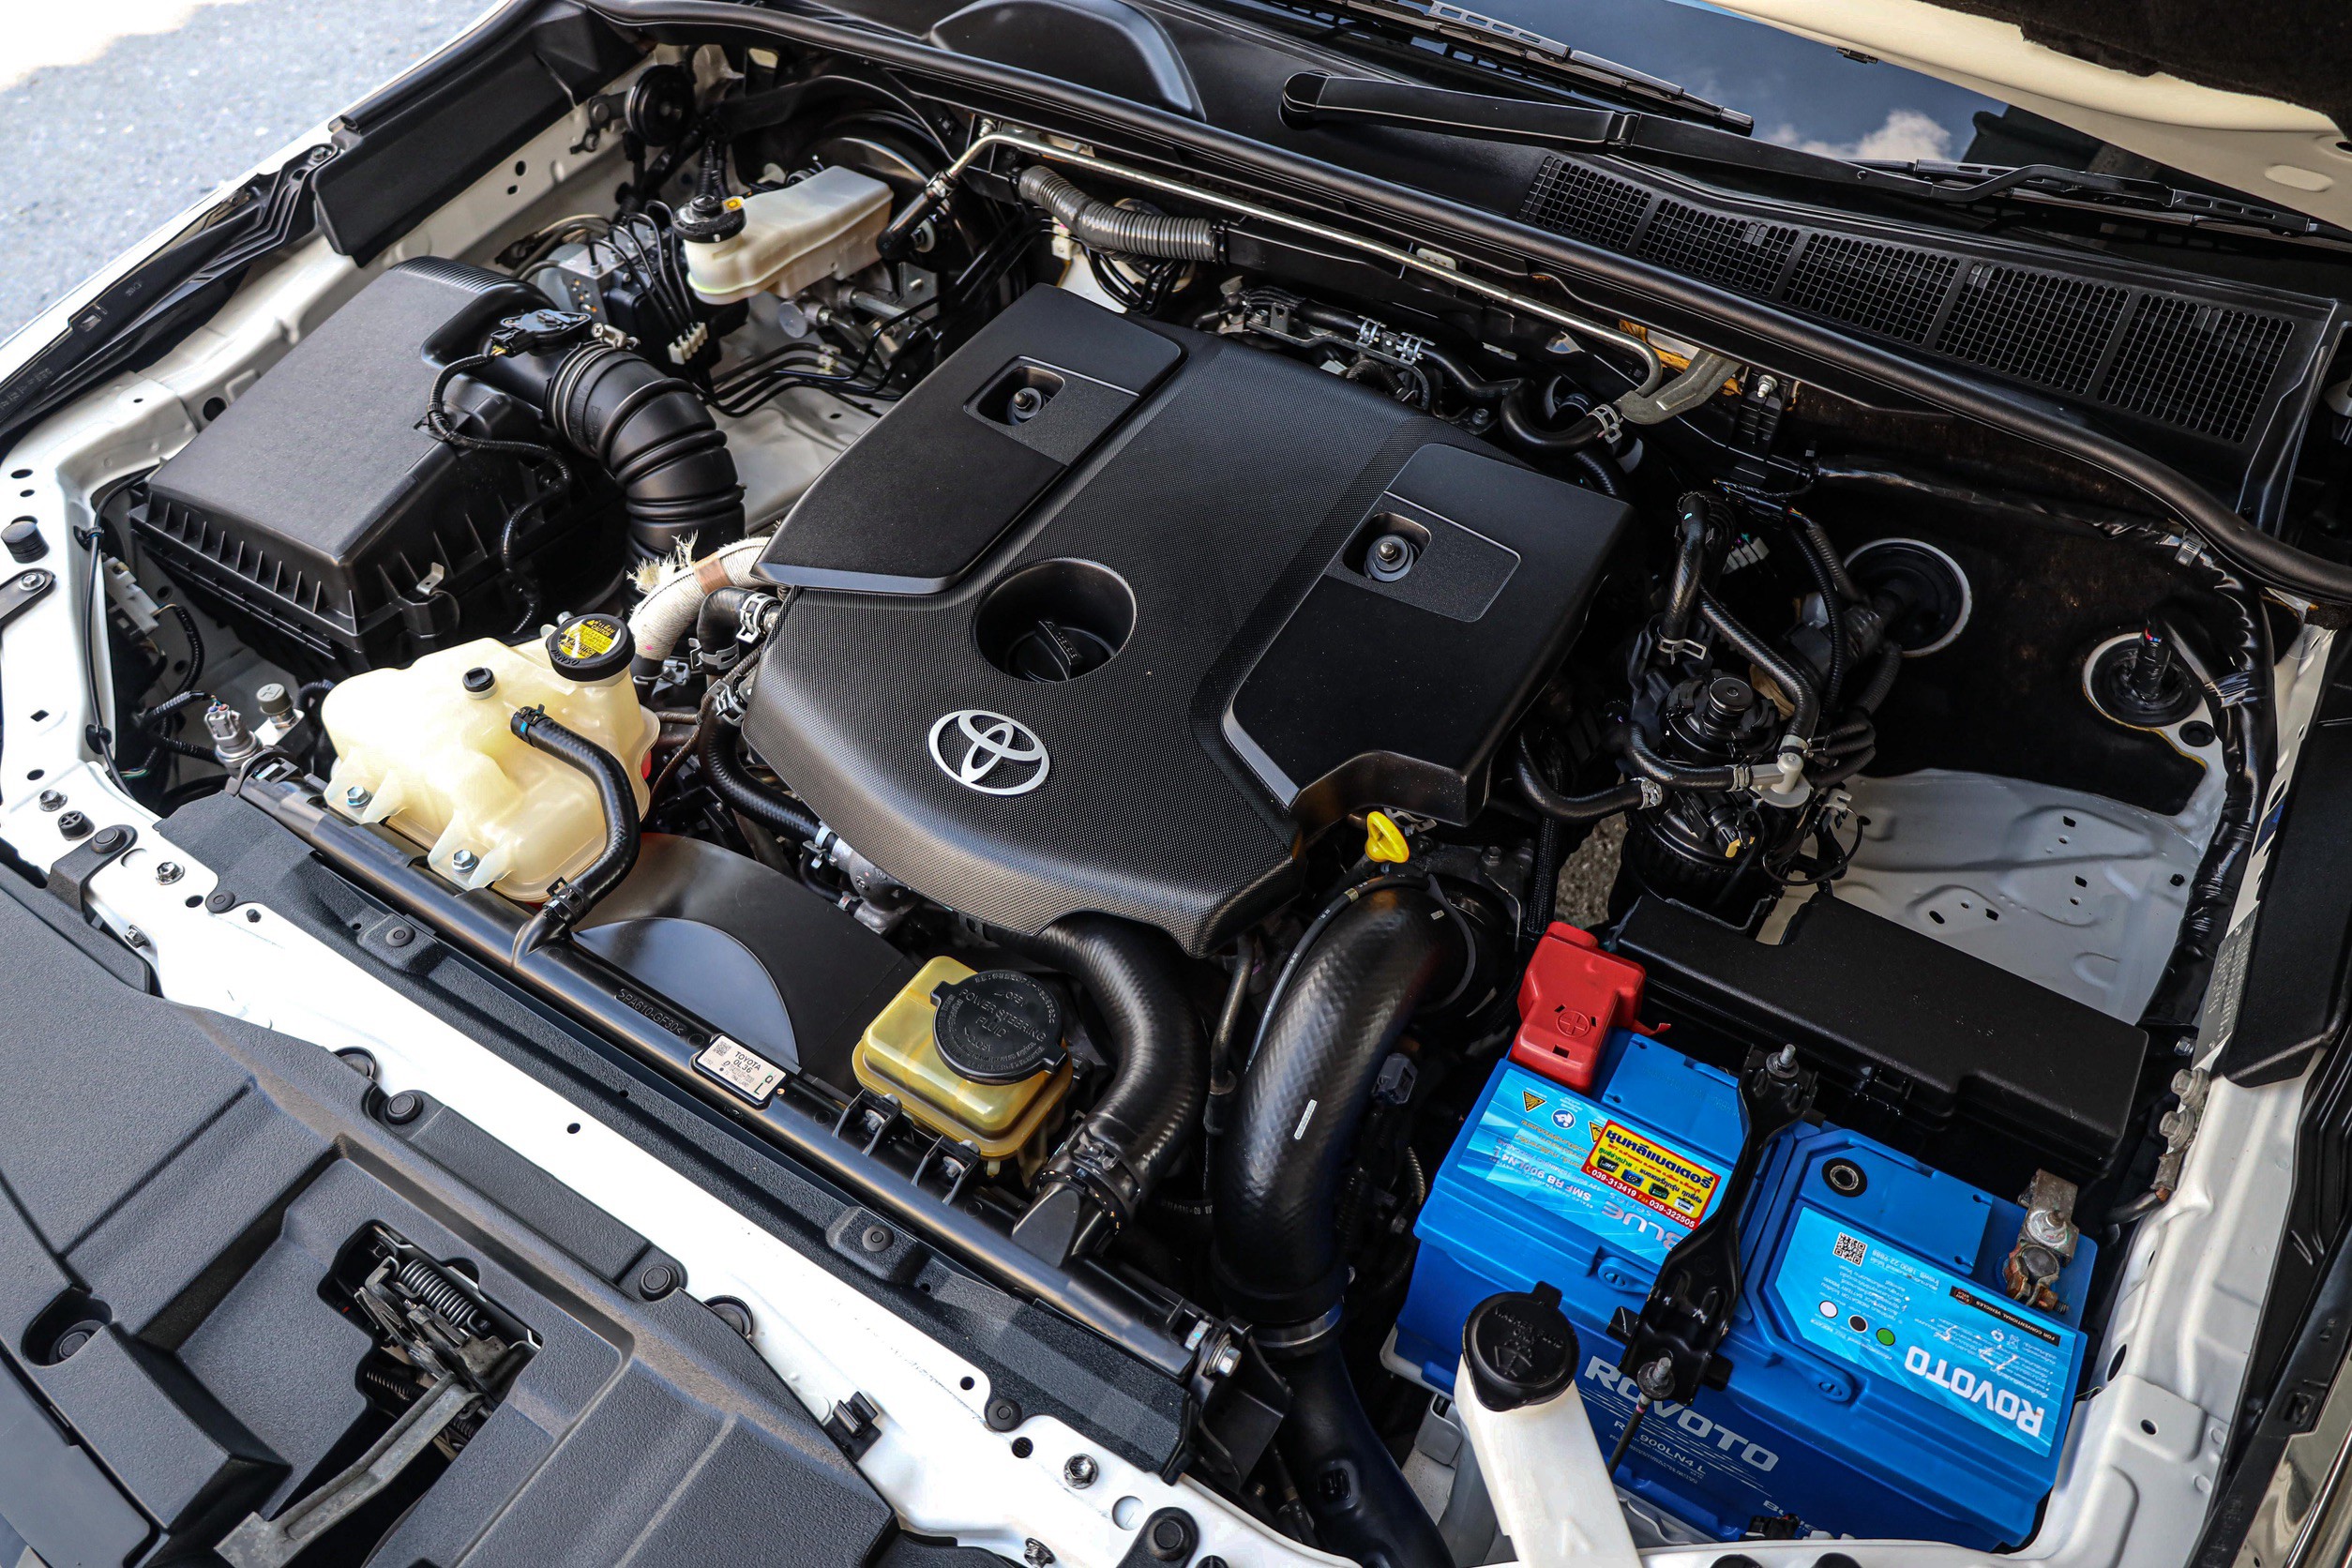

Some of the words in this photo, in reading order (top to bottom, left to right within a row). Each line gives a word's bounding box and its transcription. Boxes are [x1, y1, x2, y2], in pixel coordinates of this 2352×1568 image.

[591, 626, 611, 637] CAUTION
[1004, 989, 1030, 1009] OPEN
[957, 987, 997, 1015] POWER
[993, 1006, 1047, 1043] STEERING
[974, 1014, 1009, 1039] FLUID
[733, 1049, 761, 1071] TOYOTA
[1500, 1152, 1545, 1180] 900LN4
[1545, 1173, 1565, 1189] RB
[1564, 1183, 1592, 1202] SMF
[1591, 1168, 1637, 1198] 039-313419
[1636, 1193, 1650, 1204] Fax
[1648, 1199, 1696, 1229] 039-322505
[1606, 1191, 1652, 1218] series
[1975, 1300, 2001, 1316] VEHICLES
[2001, 1312, 2043, 1334] CONVENTIONAL
[2042, 1332, 2055, 1341] FOR
[1901, 1343, 2048, 1438] ROVOTO
[1637, 1432, 1696, 1468] 900LN4
[1696, 1463, 1709, 1474] L
